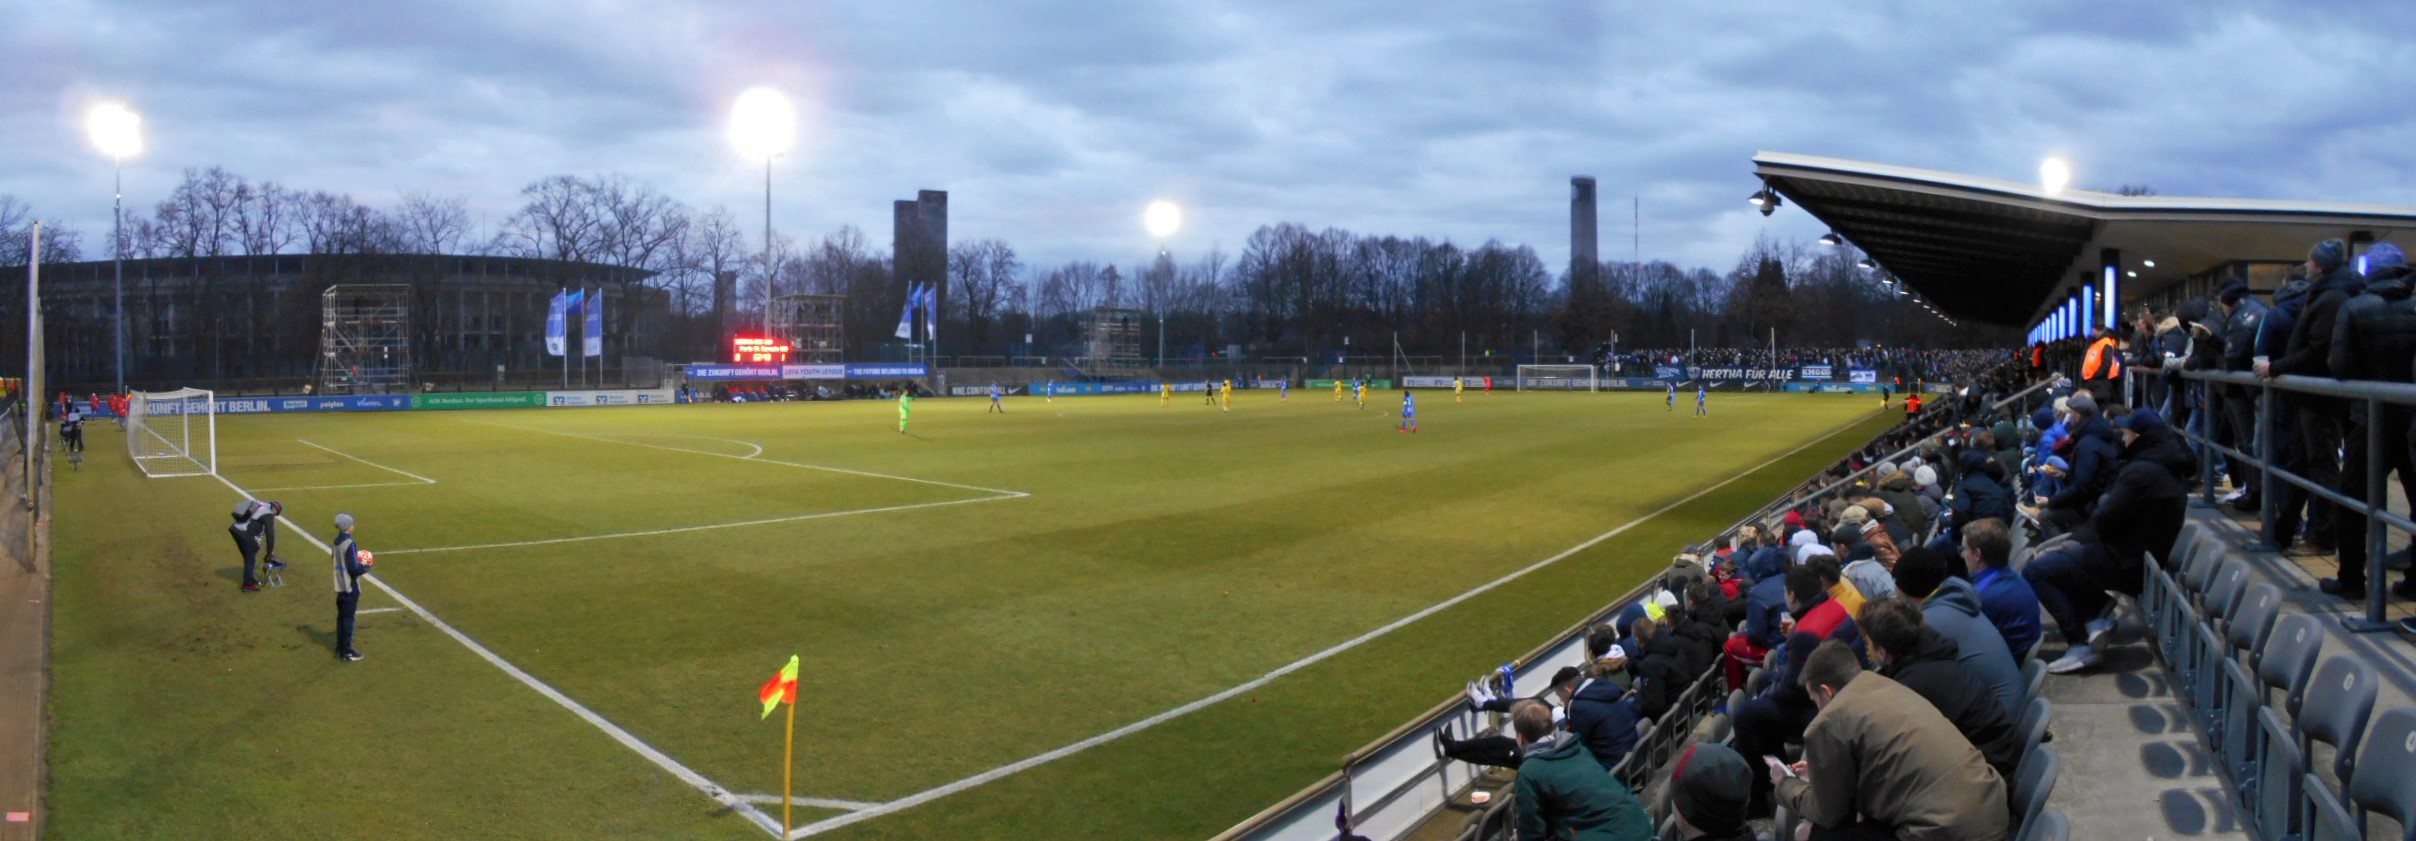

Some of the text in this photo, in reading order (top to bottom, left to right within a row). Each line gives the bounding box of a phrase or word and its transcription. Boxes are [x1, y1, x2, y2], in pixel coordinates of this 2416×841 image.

[697, 368, 707, 376] DIE
[708, 368, 734, 376] ZUKUNFT
[1702, 368, 1794, 379] HERTHA FÜR ALLE
[952, 386, 1006, 396] NIKE.COM/FOOALL
[229, 400, 271, 412] BERLIN.
